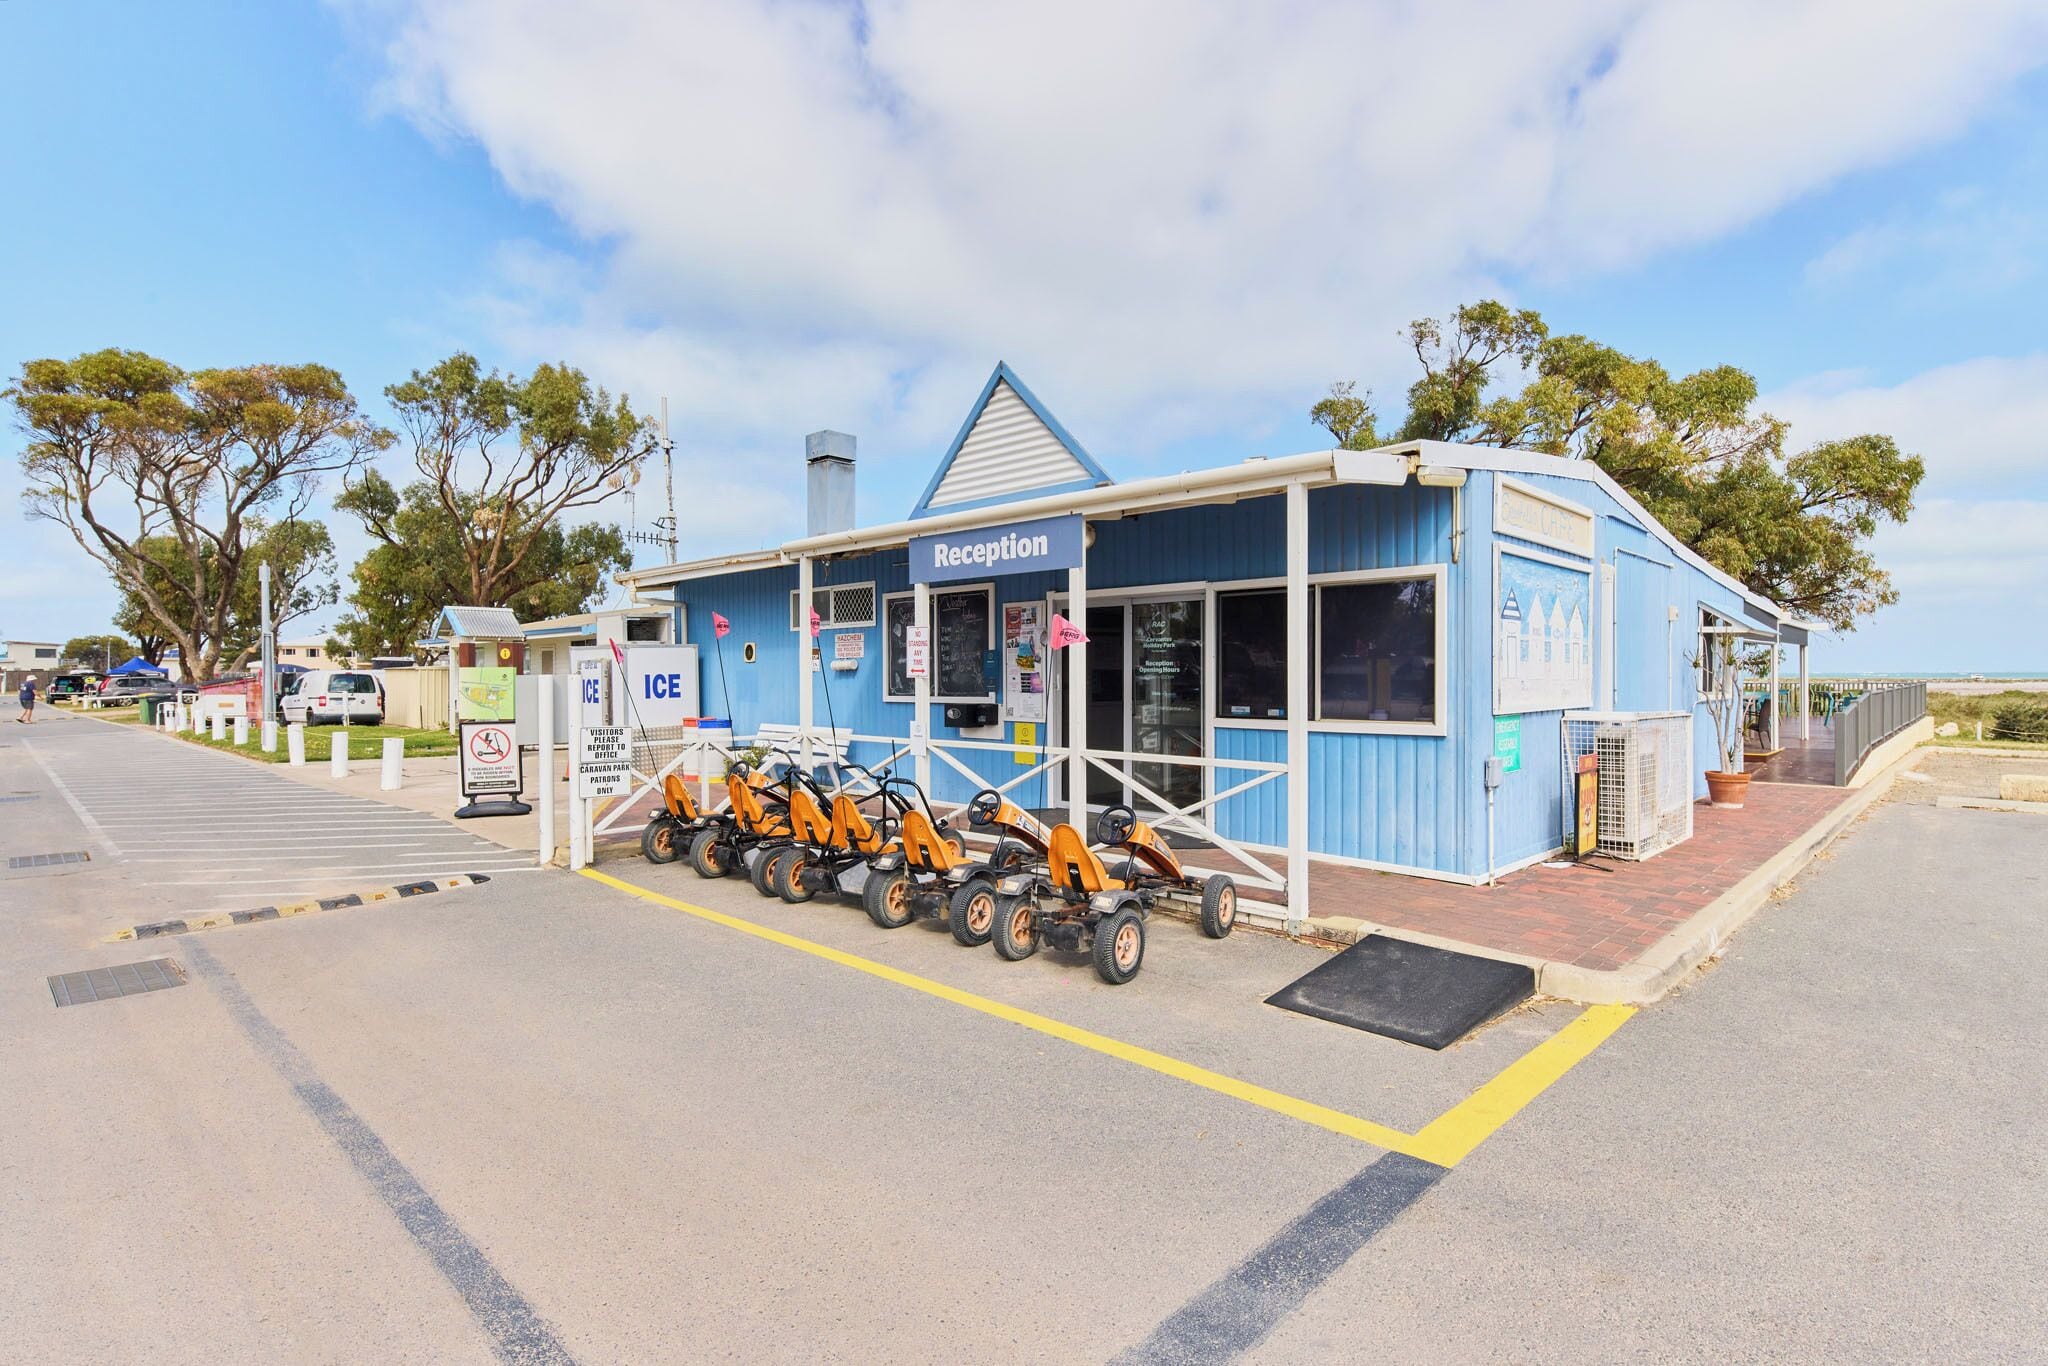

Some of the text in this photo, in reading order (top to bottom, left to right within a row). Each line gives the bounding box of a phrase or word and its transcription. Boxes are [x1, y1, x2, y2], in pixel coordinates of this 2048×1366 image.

[934, 532, 1048, 568] Reception
[837, 634, 862, 642] HAZCHEM
[1059, 630, 1080, 639] BERG
[582, 679, 599, 703] ICE
[645, 674, 681, 699] ICE
[595, 751, 618, 759] OFFICE
[580, 763, 630, 773] CARAVAN PARK
[590, 775, 621, 783] PATRONS
[596, 787, 613, 795] ONLY
